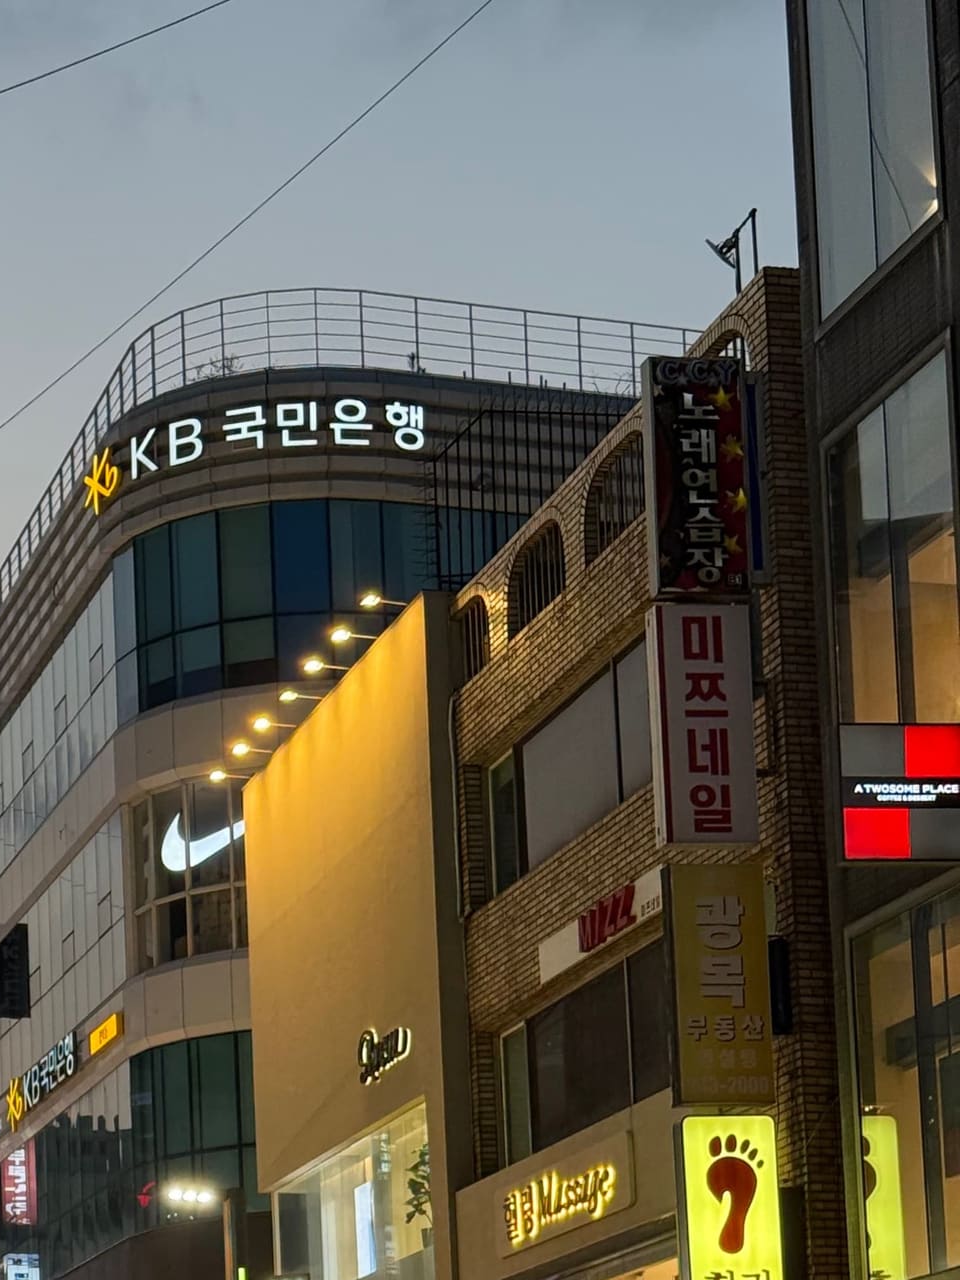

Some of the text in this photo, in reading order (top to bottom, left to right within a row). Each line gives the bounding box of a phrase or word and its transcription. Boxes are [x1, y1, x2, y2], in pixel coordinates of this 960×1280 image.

[656, 359, 738, 387] CCY
[222, 399, 425, 451] 국민은행
[677, 391, 730, 584] 노래연습장
[682, 615, 734, 834] 미쯔네일
[863, 783, 920, 794] TWOSOME
[922, 783, 959, 794] PLACE
[687, 1014, 766, 1043] 부동산
